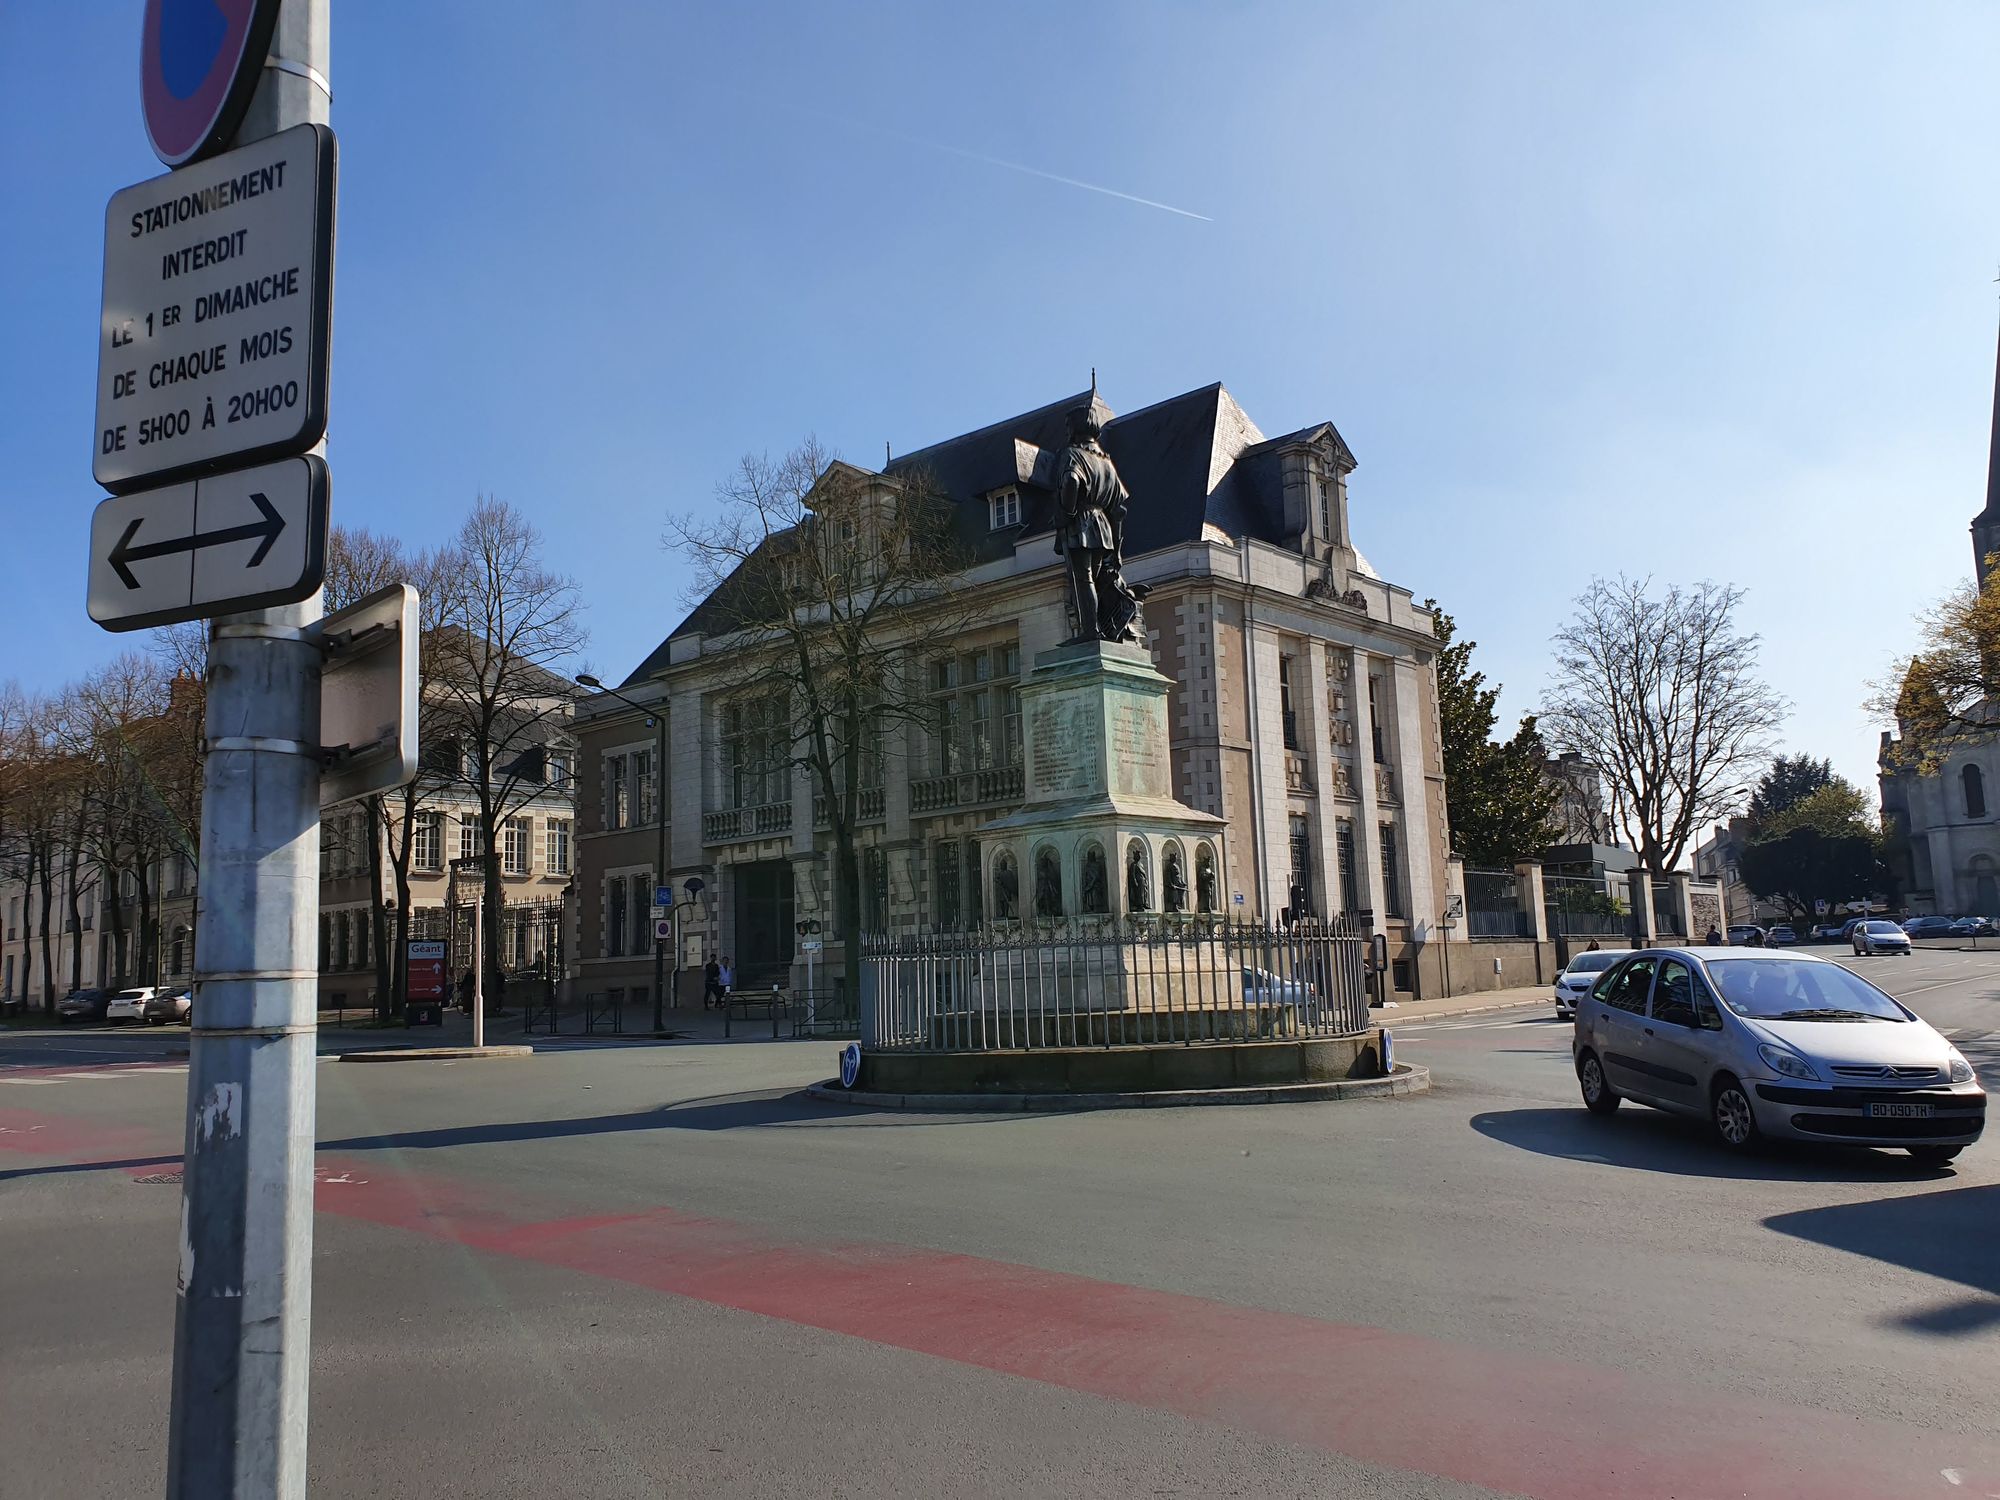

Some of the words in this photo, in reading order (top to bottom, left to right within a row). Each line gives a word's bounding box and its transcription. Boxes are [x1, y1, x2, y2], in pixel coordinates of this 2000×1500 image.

[131, 160, 287, 239] STATIONNEMENT
[162, 229, 248, 280] INTERDIT
[112, 317, 134, 349] LE
[145, 312, 154, 338] 1
[162, 304, 181, 328] ER
[194, 267, 300, 323] DIMANCHE
[113, 370, 137, 400] DE
[149, 344, 227, 389] CHAQUE
[239, 326, 293, 365] MOIS
[102, 425, 127, 455] DE
[138, 409, 190, 446] 5H00
[201, 396, 216, 430] À
[227, 380, 298, 424] 20H00
[411, 944, 441, 953] Géant
